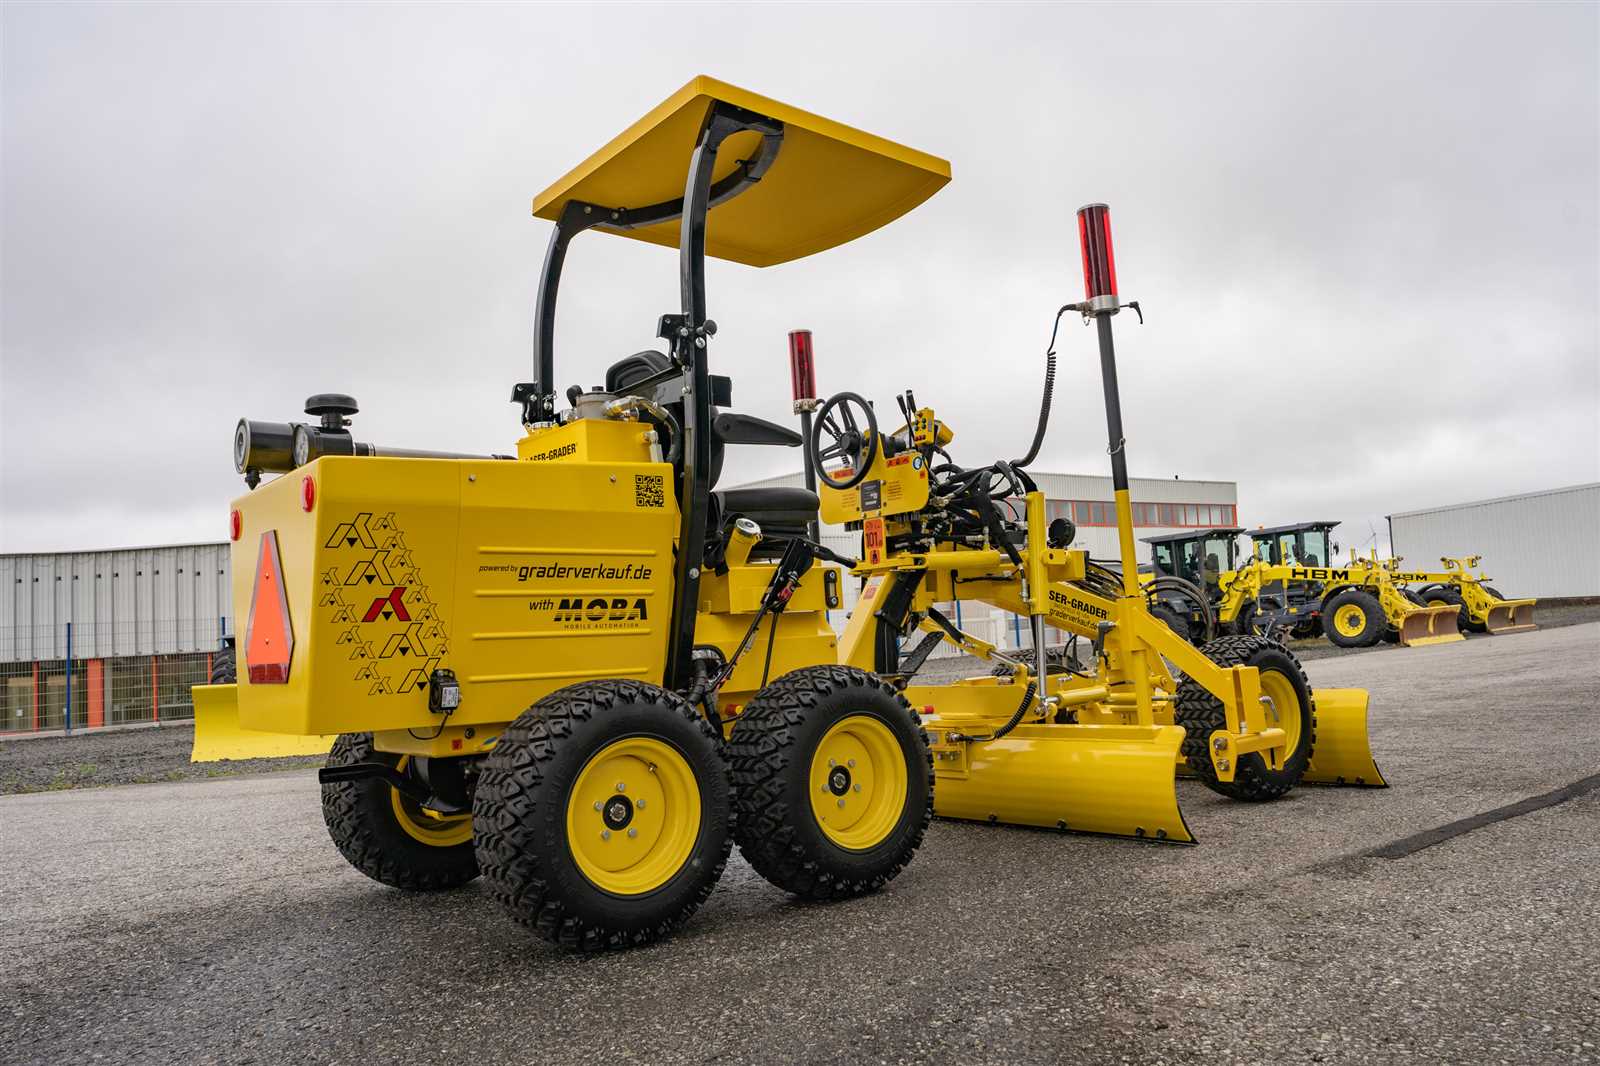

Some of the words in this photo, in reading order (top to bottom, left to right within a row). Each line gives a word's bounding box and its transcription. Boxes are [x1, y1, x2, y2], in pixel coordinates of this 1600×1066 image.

[479, 565, 509, 573] powered
[510, 564, 518, 573] by
[518, 562, 652, 582] graderverkauf.de
[1291, 568, 1349, 581] HBM
[529, 598, 554, 611] with
[554, 598, 648, 622] MOBA
[594, 622, 639, 630] AUTOMATION
